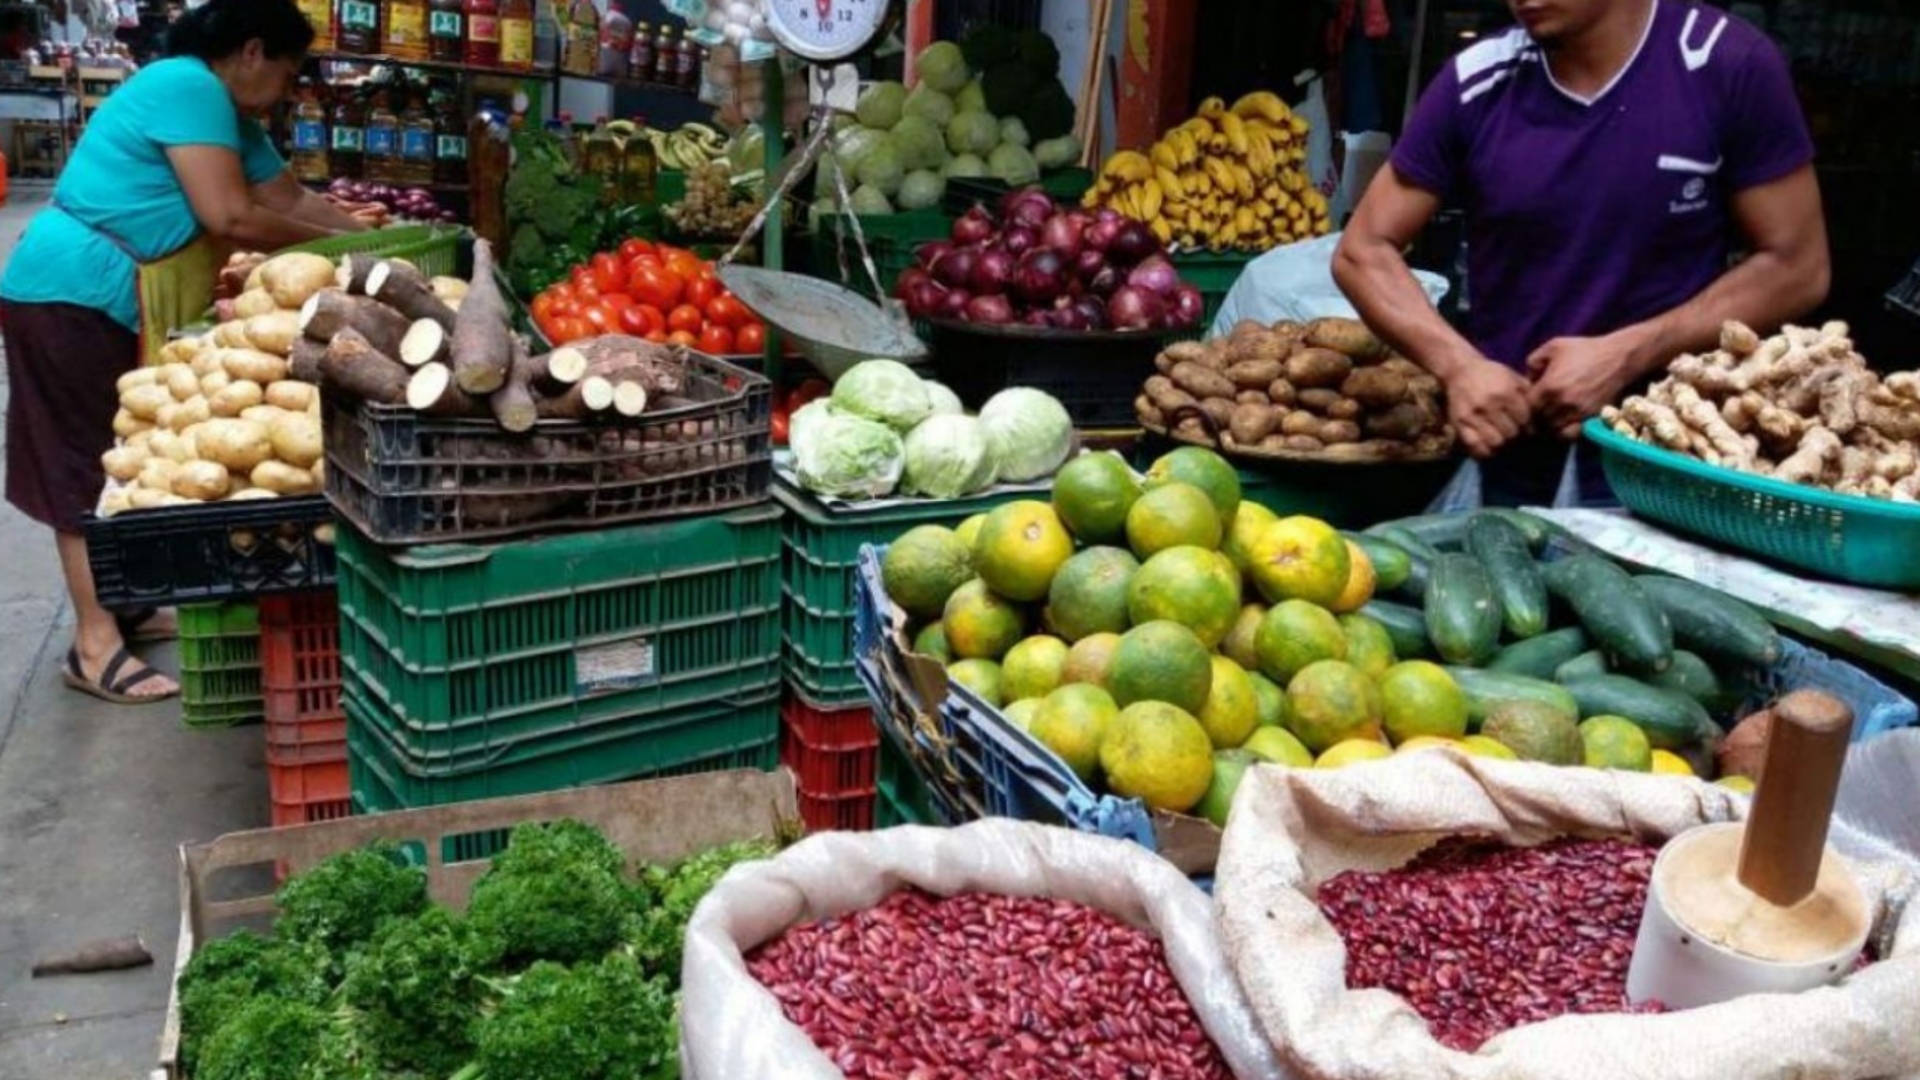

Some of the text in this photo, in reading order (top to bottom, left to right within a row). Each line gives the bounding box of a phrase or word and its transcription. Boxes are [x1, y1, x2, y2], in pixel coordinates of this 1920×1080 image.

[800, 8, 808, 20] 8
[838, 9, 853, 22] 12
[818, 20, 834, 33] 10
